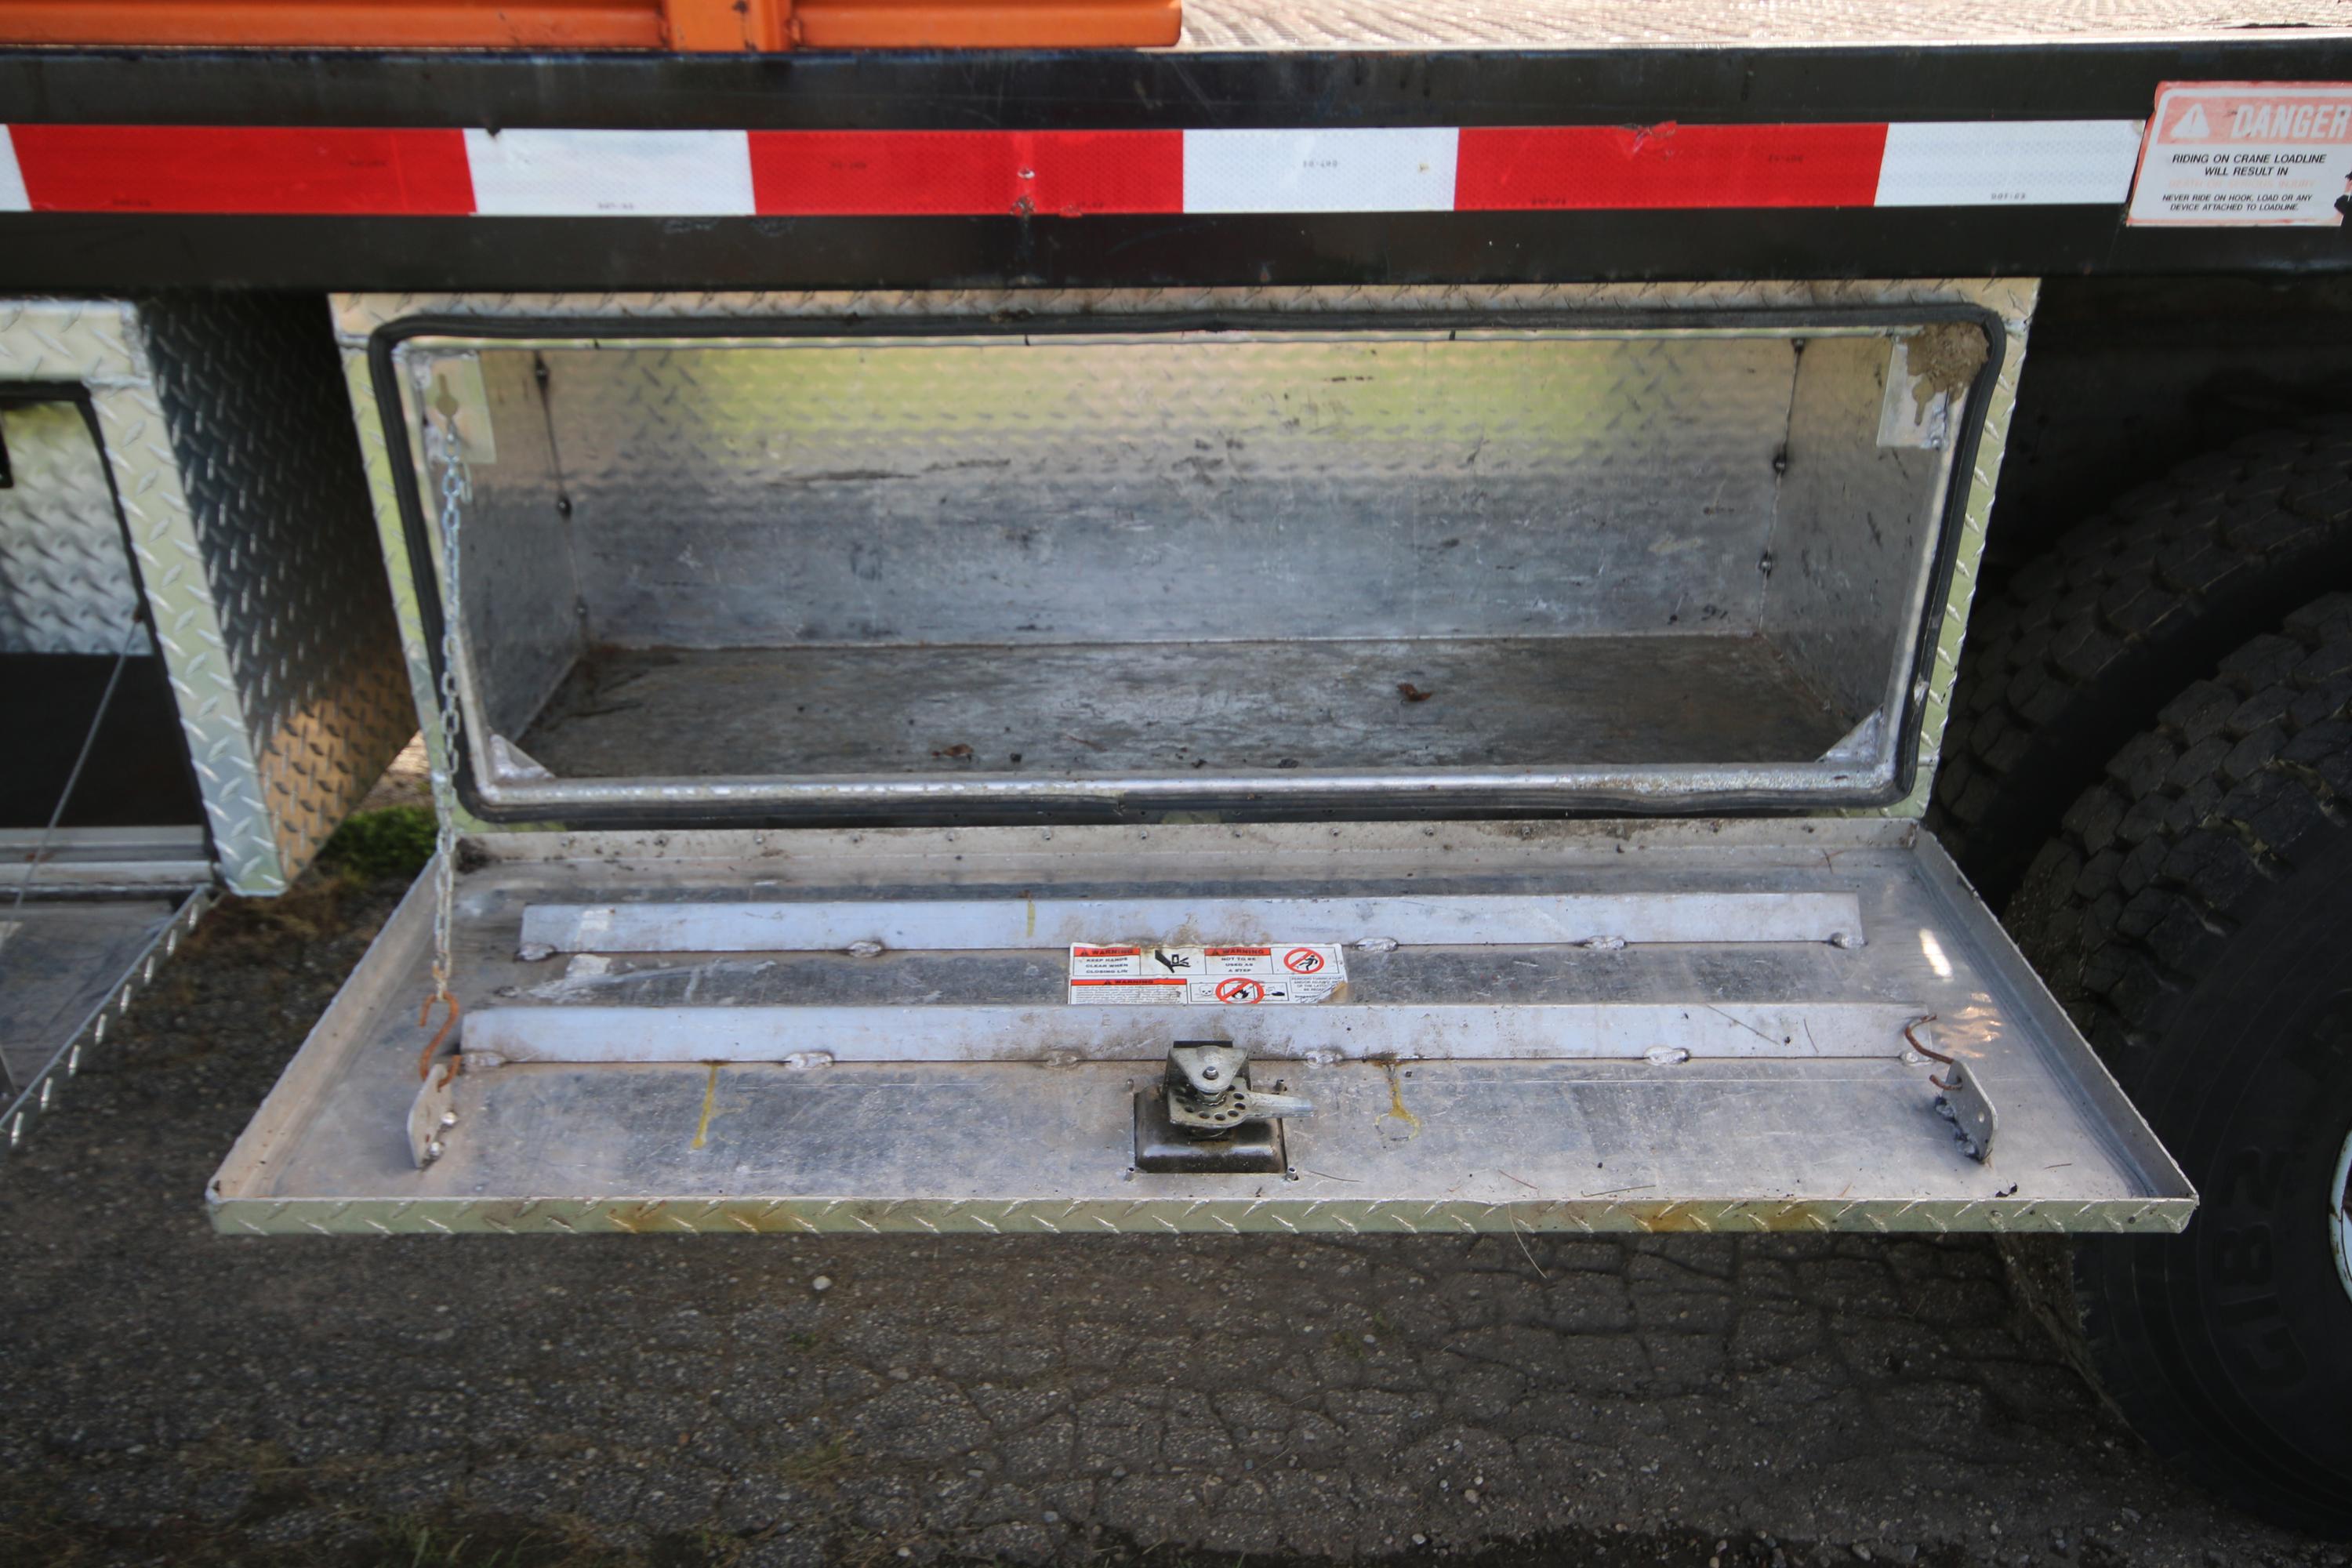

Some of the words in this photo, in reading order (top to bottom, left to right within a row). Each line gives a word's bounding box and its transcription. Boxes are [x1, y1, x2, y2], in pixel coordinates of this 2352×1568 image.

[2230, 103, 2352, 139] DANGER
[2172, 154, 2209, 164] RIDING
[2212, 154, 2230, 164] ON
[2233, 154, 2271, 164] CRANE
[2274, 154, 2327, 164] LOADLINE
[2204, 166, 2229, 176] WILL
[2232, 166, 2274, 176] RESULT
[2276, 166, 2288, 176] IN
[2169, 203, 2200, 212] DEVICE
[2201, 203, 2243, 212] ATTACHED
[2246, 203, 2257, 212] TO
